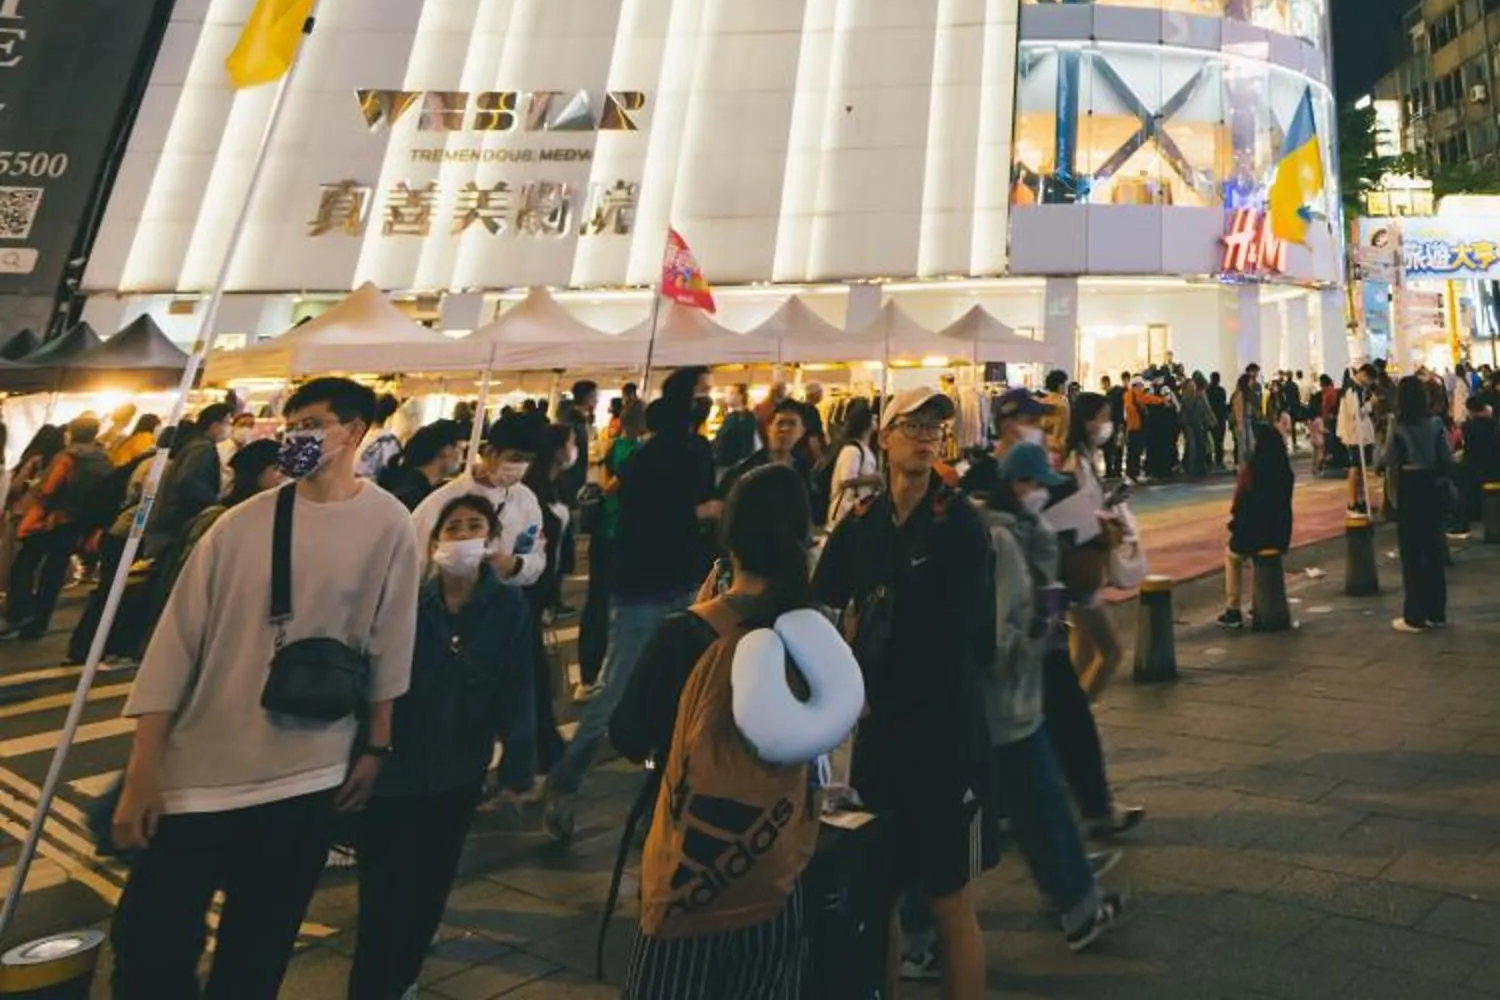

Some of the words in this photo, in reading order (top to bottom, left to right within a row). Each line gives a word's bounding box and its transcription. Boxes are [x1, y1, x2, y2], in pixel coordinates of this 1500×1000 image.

[410, 148, 532, 164] TREMENDOUS
[539, 148, 592, 163] MEDIA
[308, 178, 640, 238] 真善美劇院
